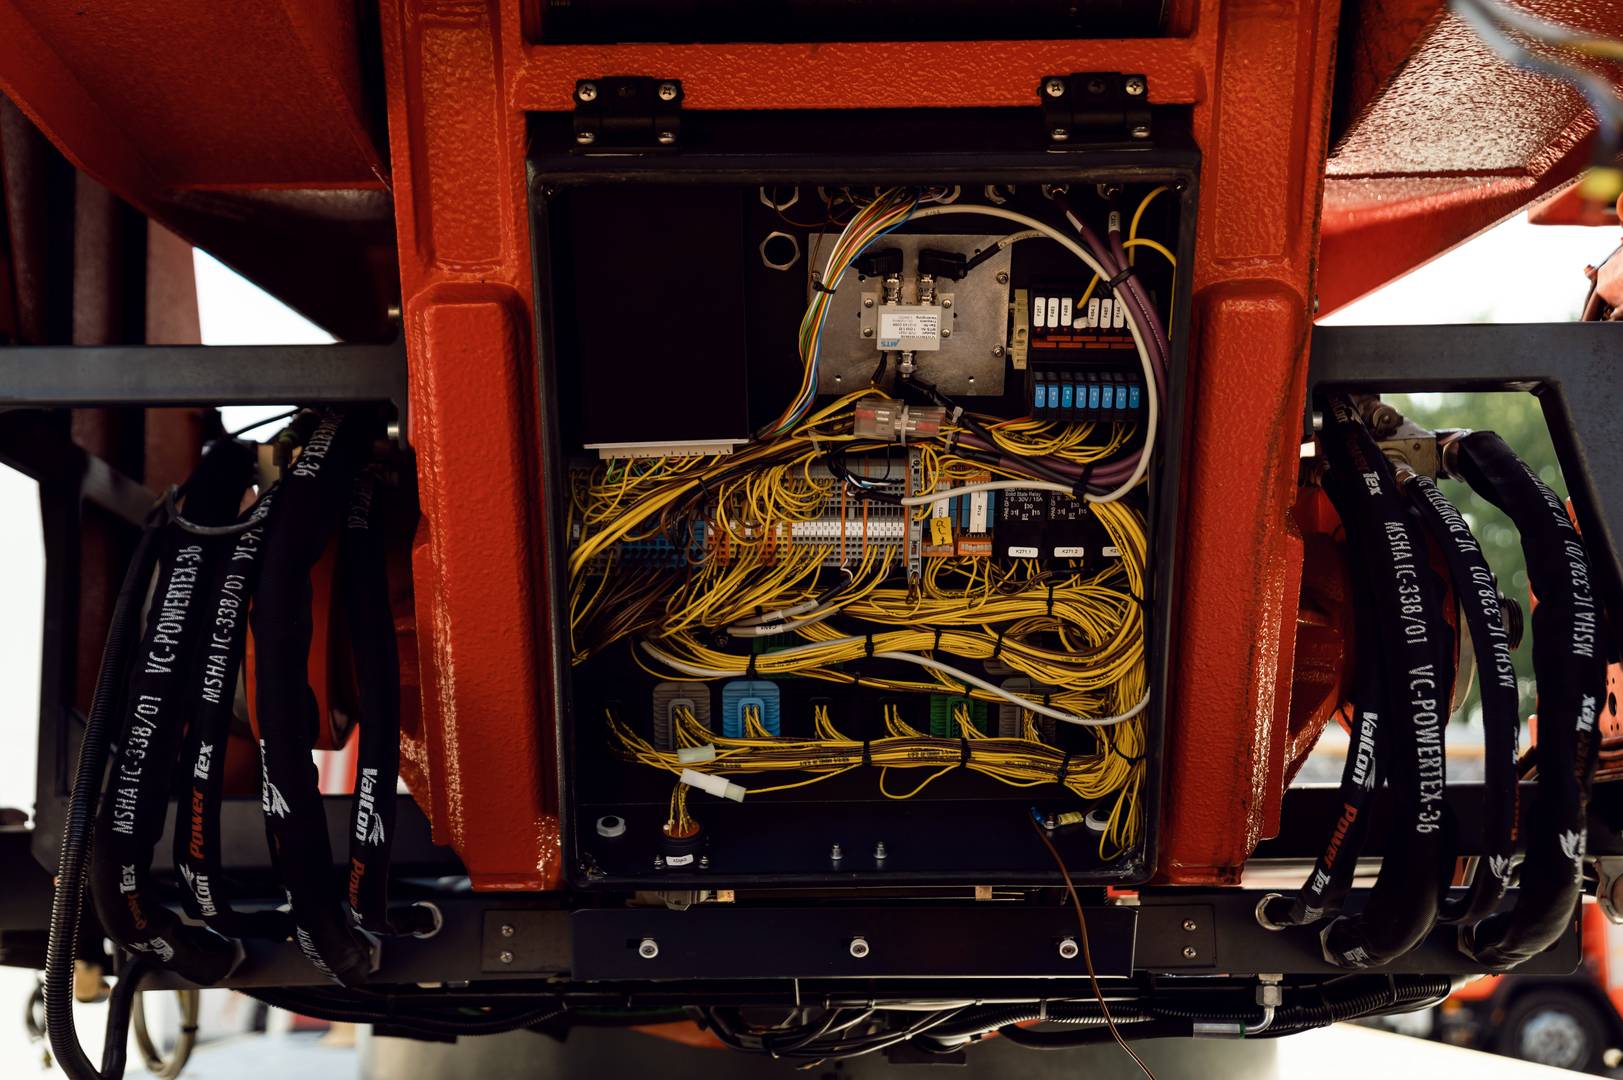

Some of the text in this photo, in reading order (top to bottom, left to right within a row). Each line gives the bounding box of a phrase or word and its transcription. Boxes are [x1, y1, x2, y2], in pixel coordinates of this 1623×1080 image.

[1362, 471, 1384, 497] Tex
[145, 544, 204, 675] VC-POWERTEX-36
[1470, 565, 1516, 689] MSHA IC-338/01
[1563, 538, 1595, 659] MSHA IC-338/01
[202, 574, 247, 704] MSHA IC-338/01
[1384, 521, 1447, 835] MSHA IC-338/01 VC-POWERTEX-36
[1575, 693, 1598, 732] Tex
[111, 695, 162, 835] MSHA IC-338/01
[193, 740, 215, 781] Tex
[1352, 711, 1378, 787] ValCon
[189, 788, 205, 860] Power
[355, 767, 379, 844] ValCon
[1323, 803, 1359, 869] Power
[120, 864, 137, 894] Tex
[1310, 868, 1332, 896] Tex
